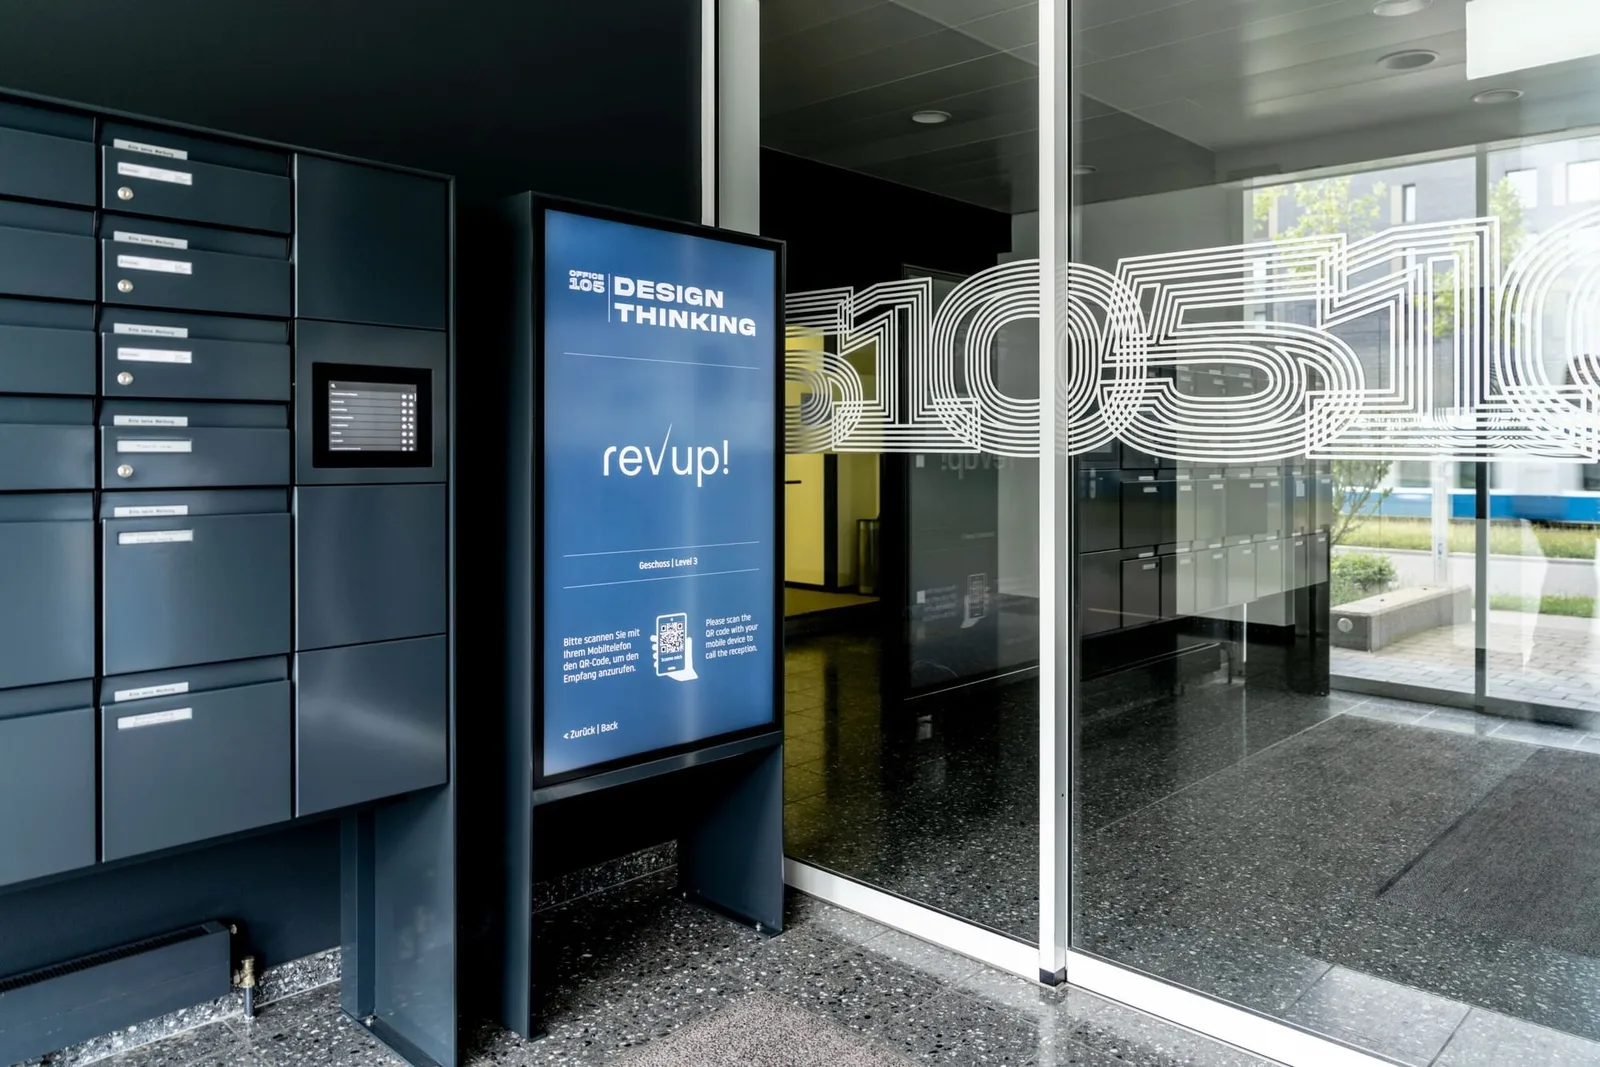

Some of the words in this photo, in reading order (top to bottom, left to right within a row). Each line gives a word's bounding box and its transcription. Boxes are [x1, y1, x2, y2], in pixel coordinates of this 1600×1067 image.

[569, 269, 604, 280] OFFICE
[569, 277, 605, 293] 105
[614, 276, 723, 309] DESIGN
[614, 302, 756, 337] THINKING
[603, 422, 729, 488] revup!
[639, 559, 670, 570] Geschoss
[675, 558, 692, 566] Level
[693, 557, 698, 565] 3
[706, 617, 725, 626] Please
[716, 627, 730, 636] code
[731, 626, 744, 634] with
[745, 624, 758, 633] your
[564, 637, 582, 646] Bitte
[584, 634, 614, 644] scannen
[615, 630, 626, 640] Sie
[627, 629, 640, 638] mit
[706, 639, 726, 648] mobile
[727, 636, 746, 645] device
[564, 649, 586, 659] Ihrem
[587, 642, 631, 656] Mobiltelefon
[706, 650, 716, 660] call
[718, 648, 727, 658] the
[728, 644, 758, 657] reception.
[564, 662, 577, 671] den
[579, 657, 611, 669] QR-Code,
[612, 655, 625, 663] um
[626, 652, 639, 662] den
[564, 670, 596, 684] Empfang
[598, 665, 636, 678] anzurufen.
[570, 724, 595, 739] Zurück
[601, 722, 618, 732] Back
